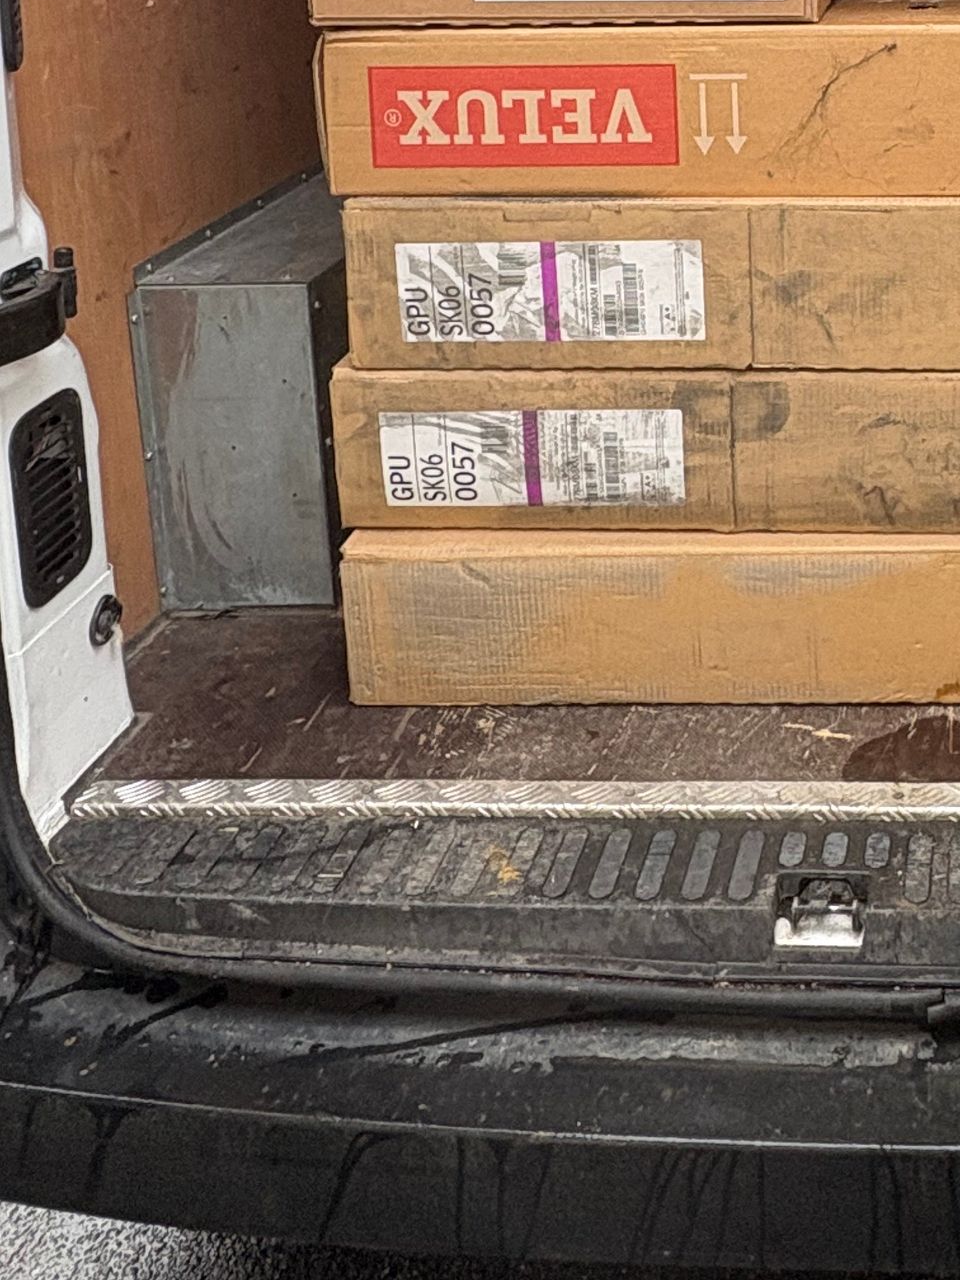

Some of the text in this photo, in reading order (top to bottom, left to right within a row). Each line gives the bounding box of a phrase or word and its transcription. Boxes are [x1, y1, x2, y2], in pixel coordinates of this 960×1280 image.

[404, 287, 431, 336] GPU
[437, 285, 464, 336] SK06
[467, 273, 495, 336] 0057
[388, 456, 414, 501] GPU
[419, 454, 447, 501] SK06
[451, 441, 478, 501] 0057
